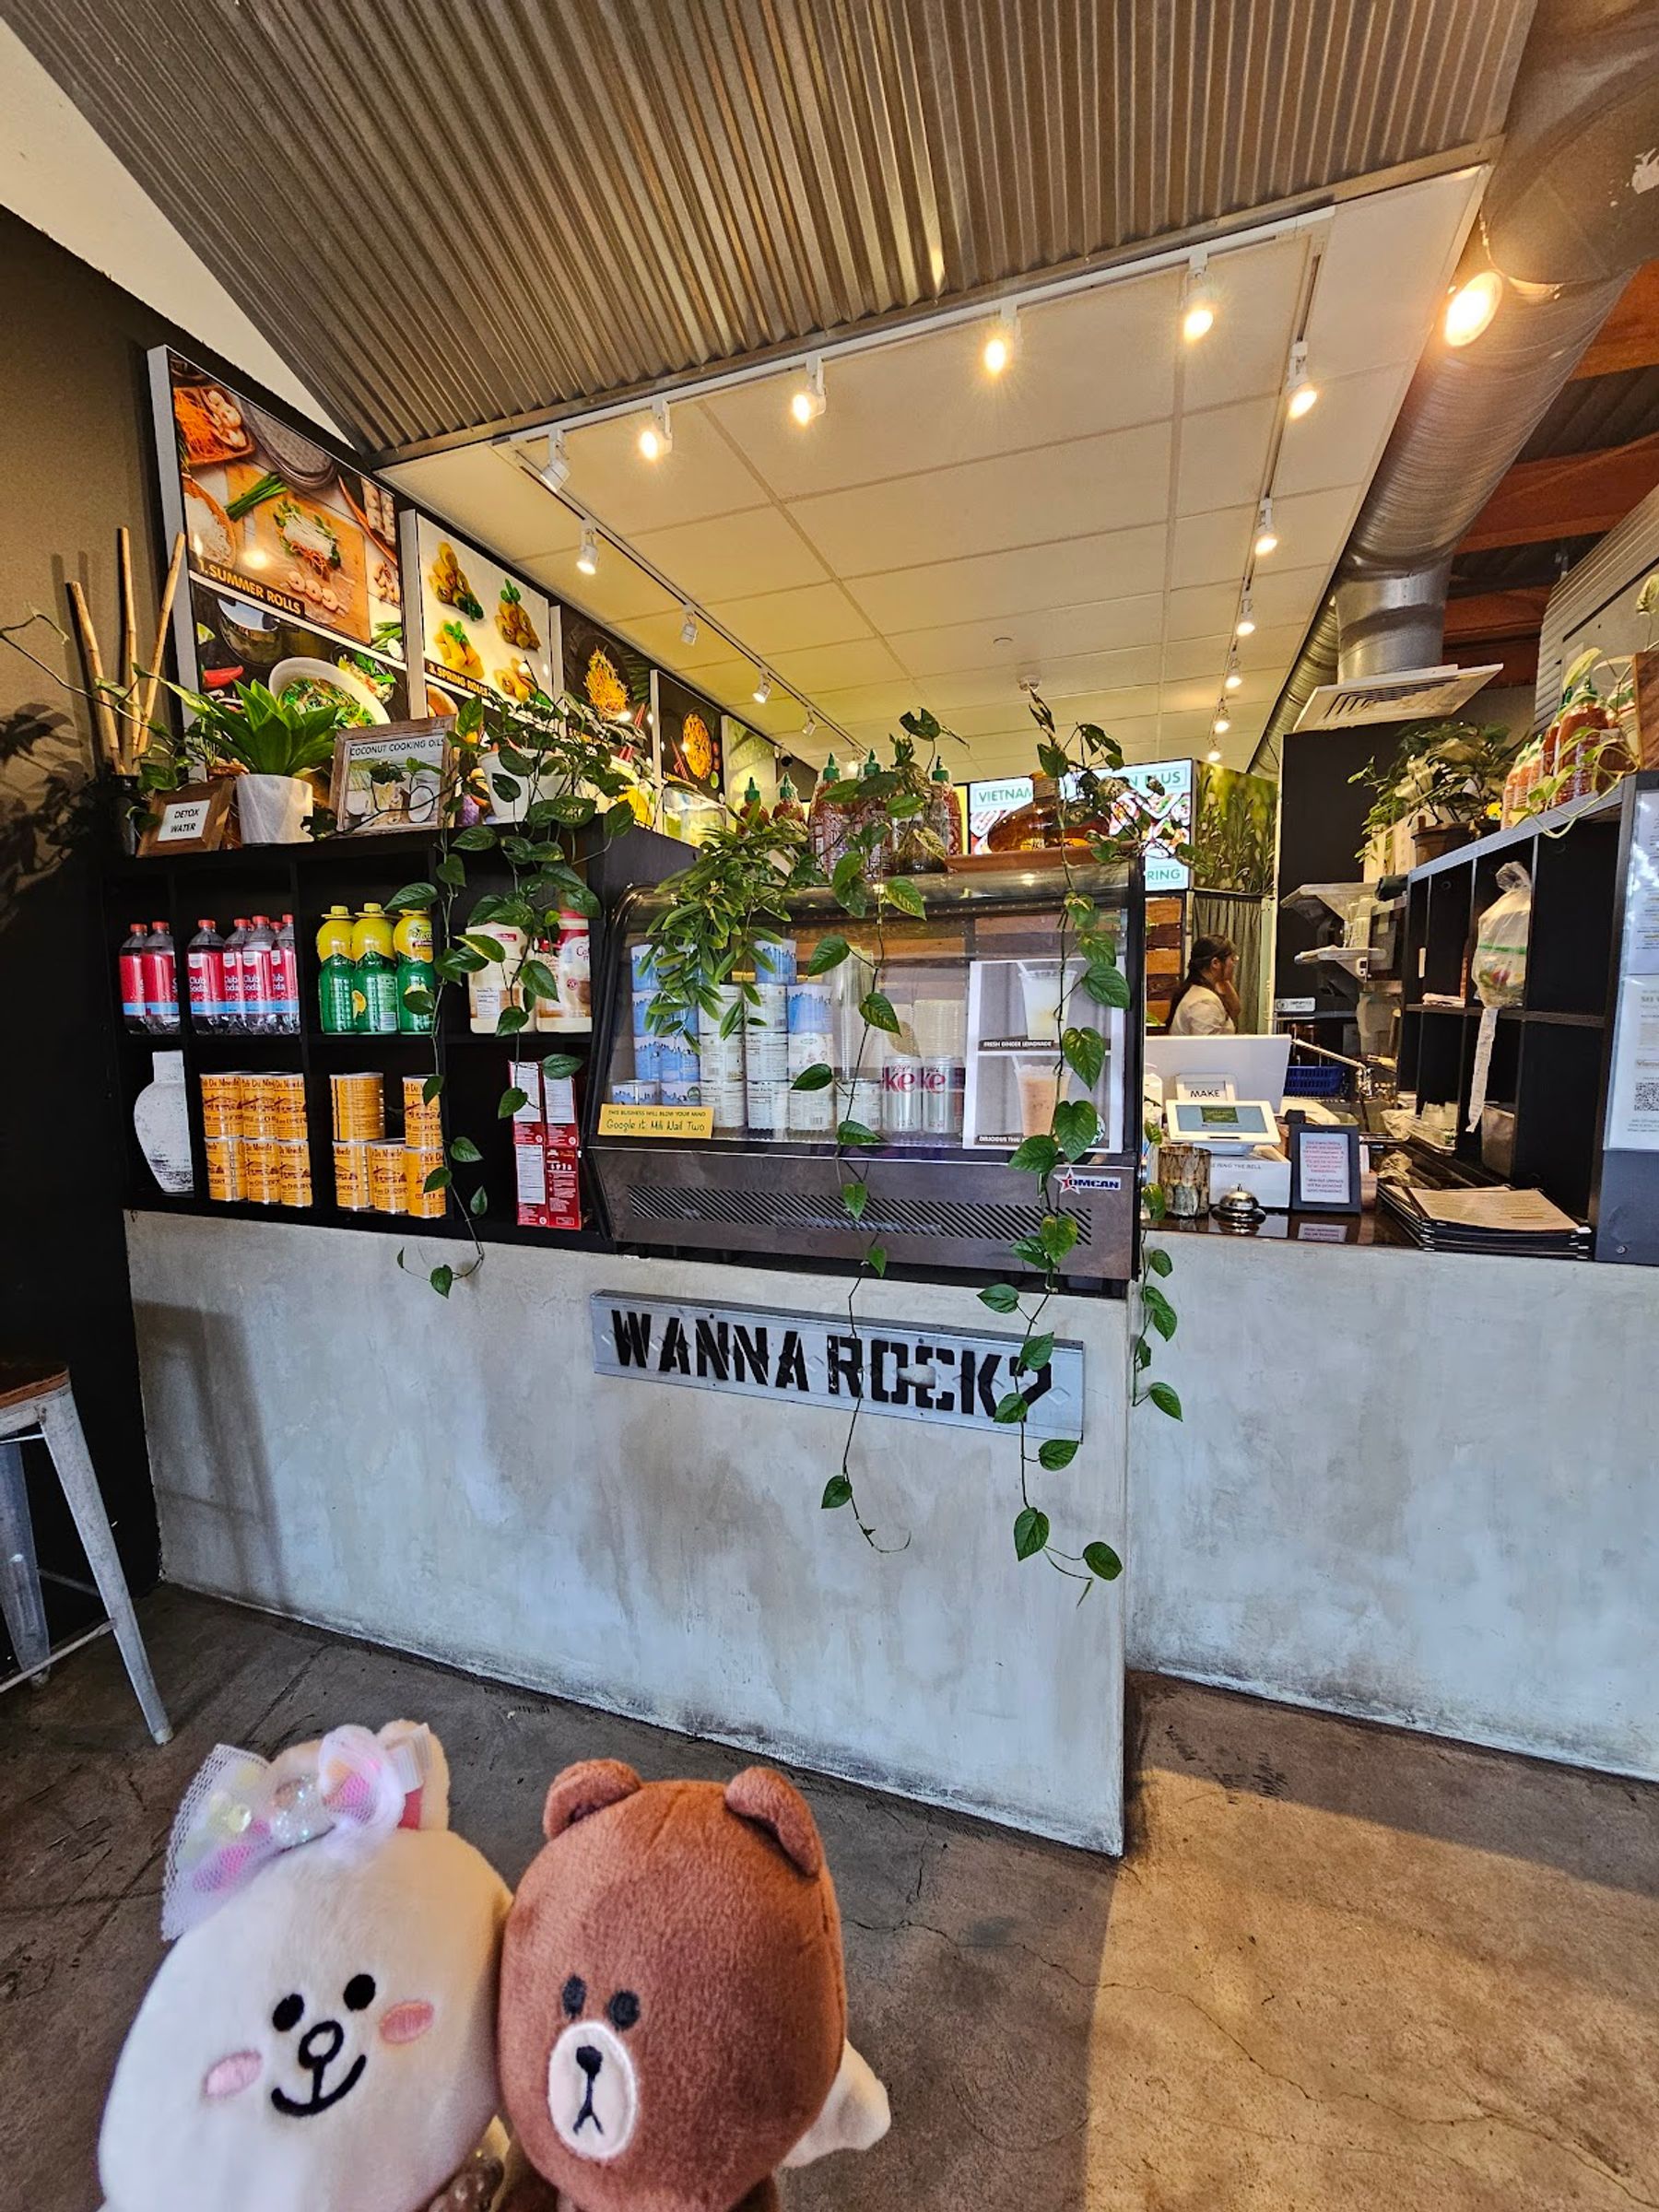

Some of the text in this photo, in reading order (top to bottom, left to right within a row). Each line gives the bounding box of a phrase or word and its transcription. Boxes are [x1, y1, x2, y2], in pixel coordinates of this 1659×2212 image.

[266, 589, 301, 616] ROLLS
[437, 665, 466, 688] SPRING
[350, 745, 387, 757] COCONUT
[389, 738, 426, 753] COOKING
[174, 808, 200, 819] DETOX
[171, 822, 196, 833] WATER
[1147, 868, 1181, 881] RING
[1190, 1089, 1220, 1098] MAKE
[606, 1118, 635, 1133] Google
[687, 1121, 705, 1132] Two
[611, 1310, 1052, 1421] WANNA ROCK?
